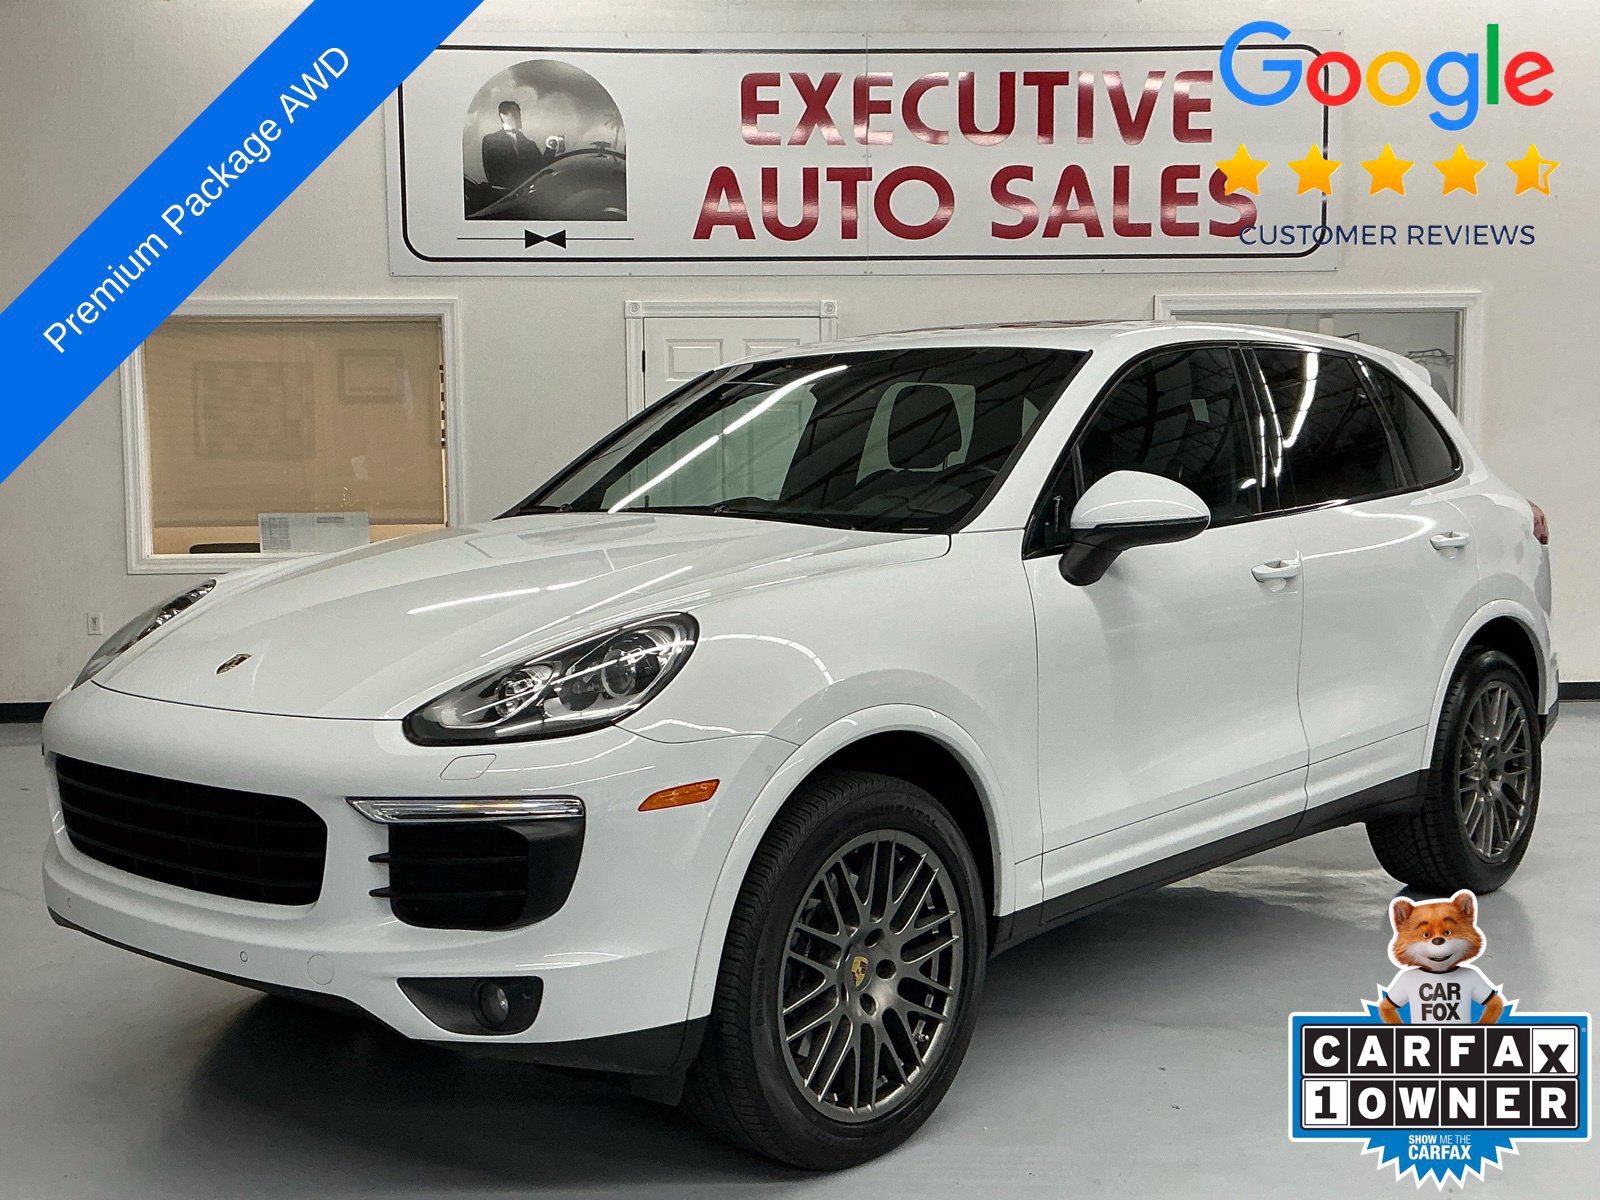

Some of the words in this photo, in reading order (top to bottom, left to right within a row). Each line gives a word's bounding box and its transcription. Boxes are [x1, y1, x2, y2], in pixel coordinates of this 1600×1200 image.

[740, 70, 1214, 146] EXECUTIVE
[693, 165, 955, 241] AUTO
[990, 164, 1258, 240] SALES
